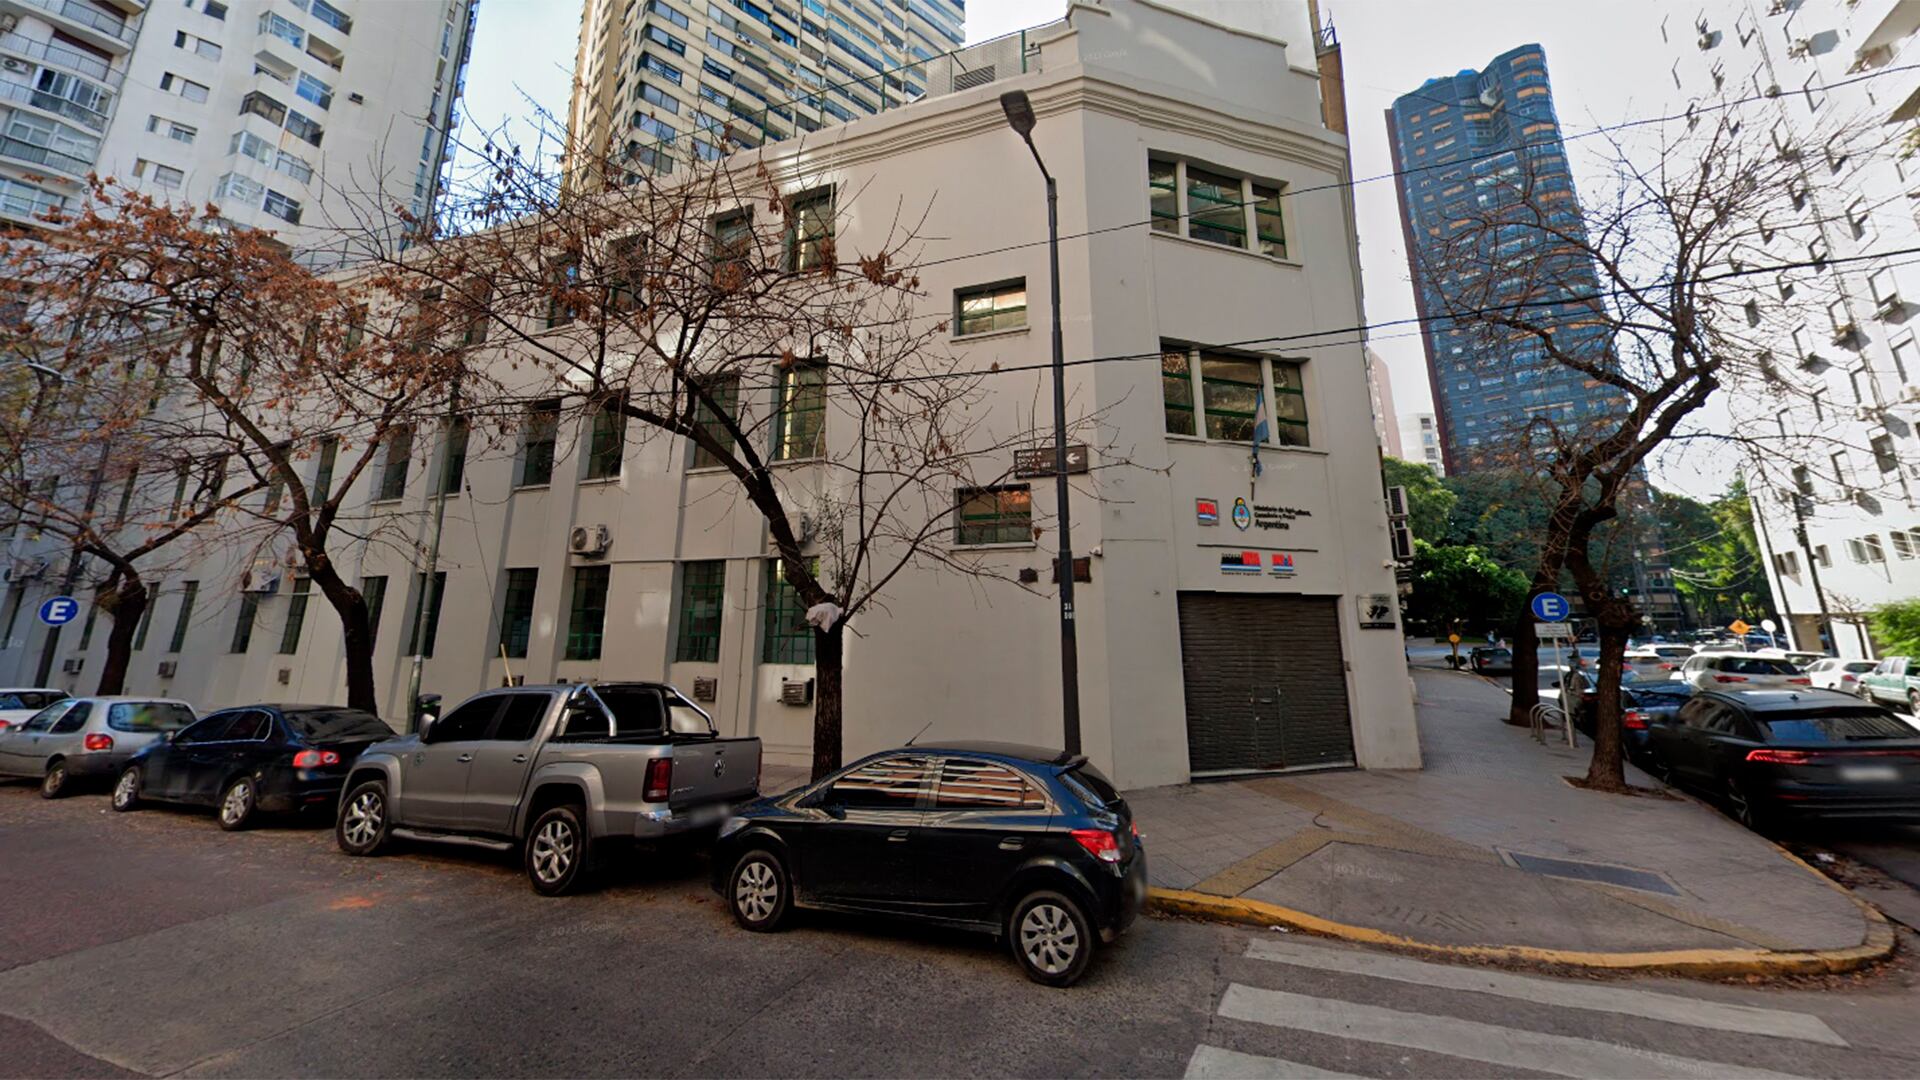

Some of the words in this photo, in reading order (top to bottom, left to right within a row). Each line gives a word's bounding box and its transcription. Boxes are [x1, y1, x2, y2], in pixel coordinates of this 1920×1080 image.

[1255, 519, 1289, 531] Argentina
[48, 601, 71, 621] E
[1541, 598, 1560, 617] E
